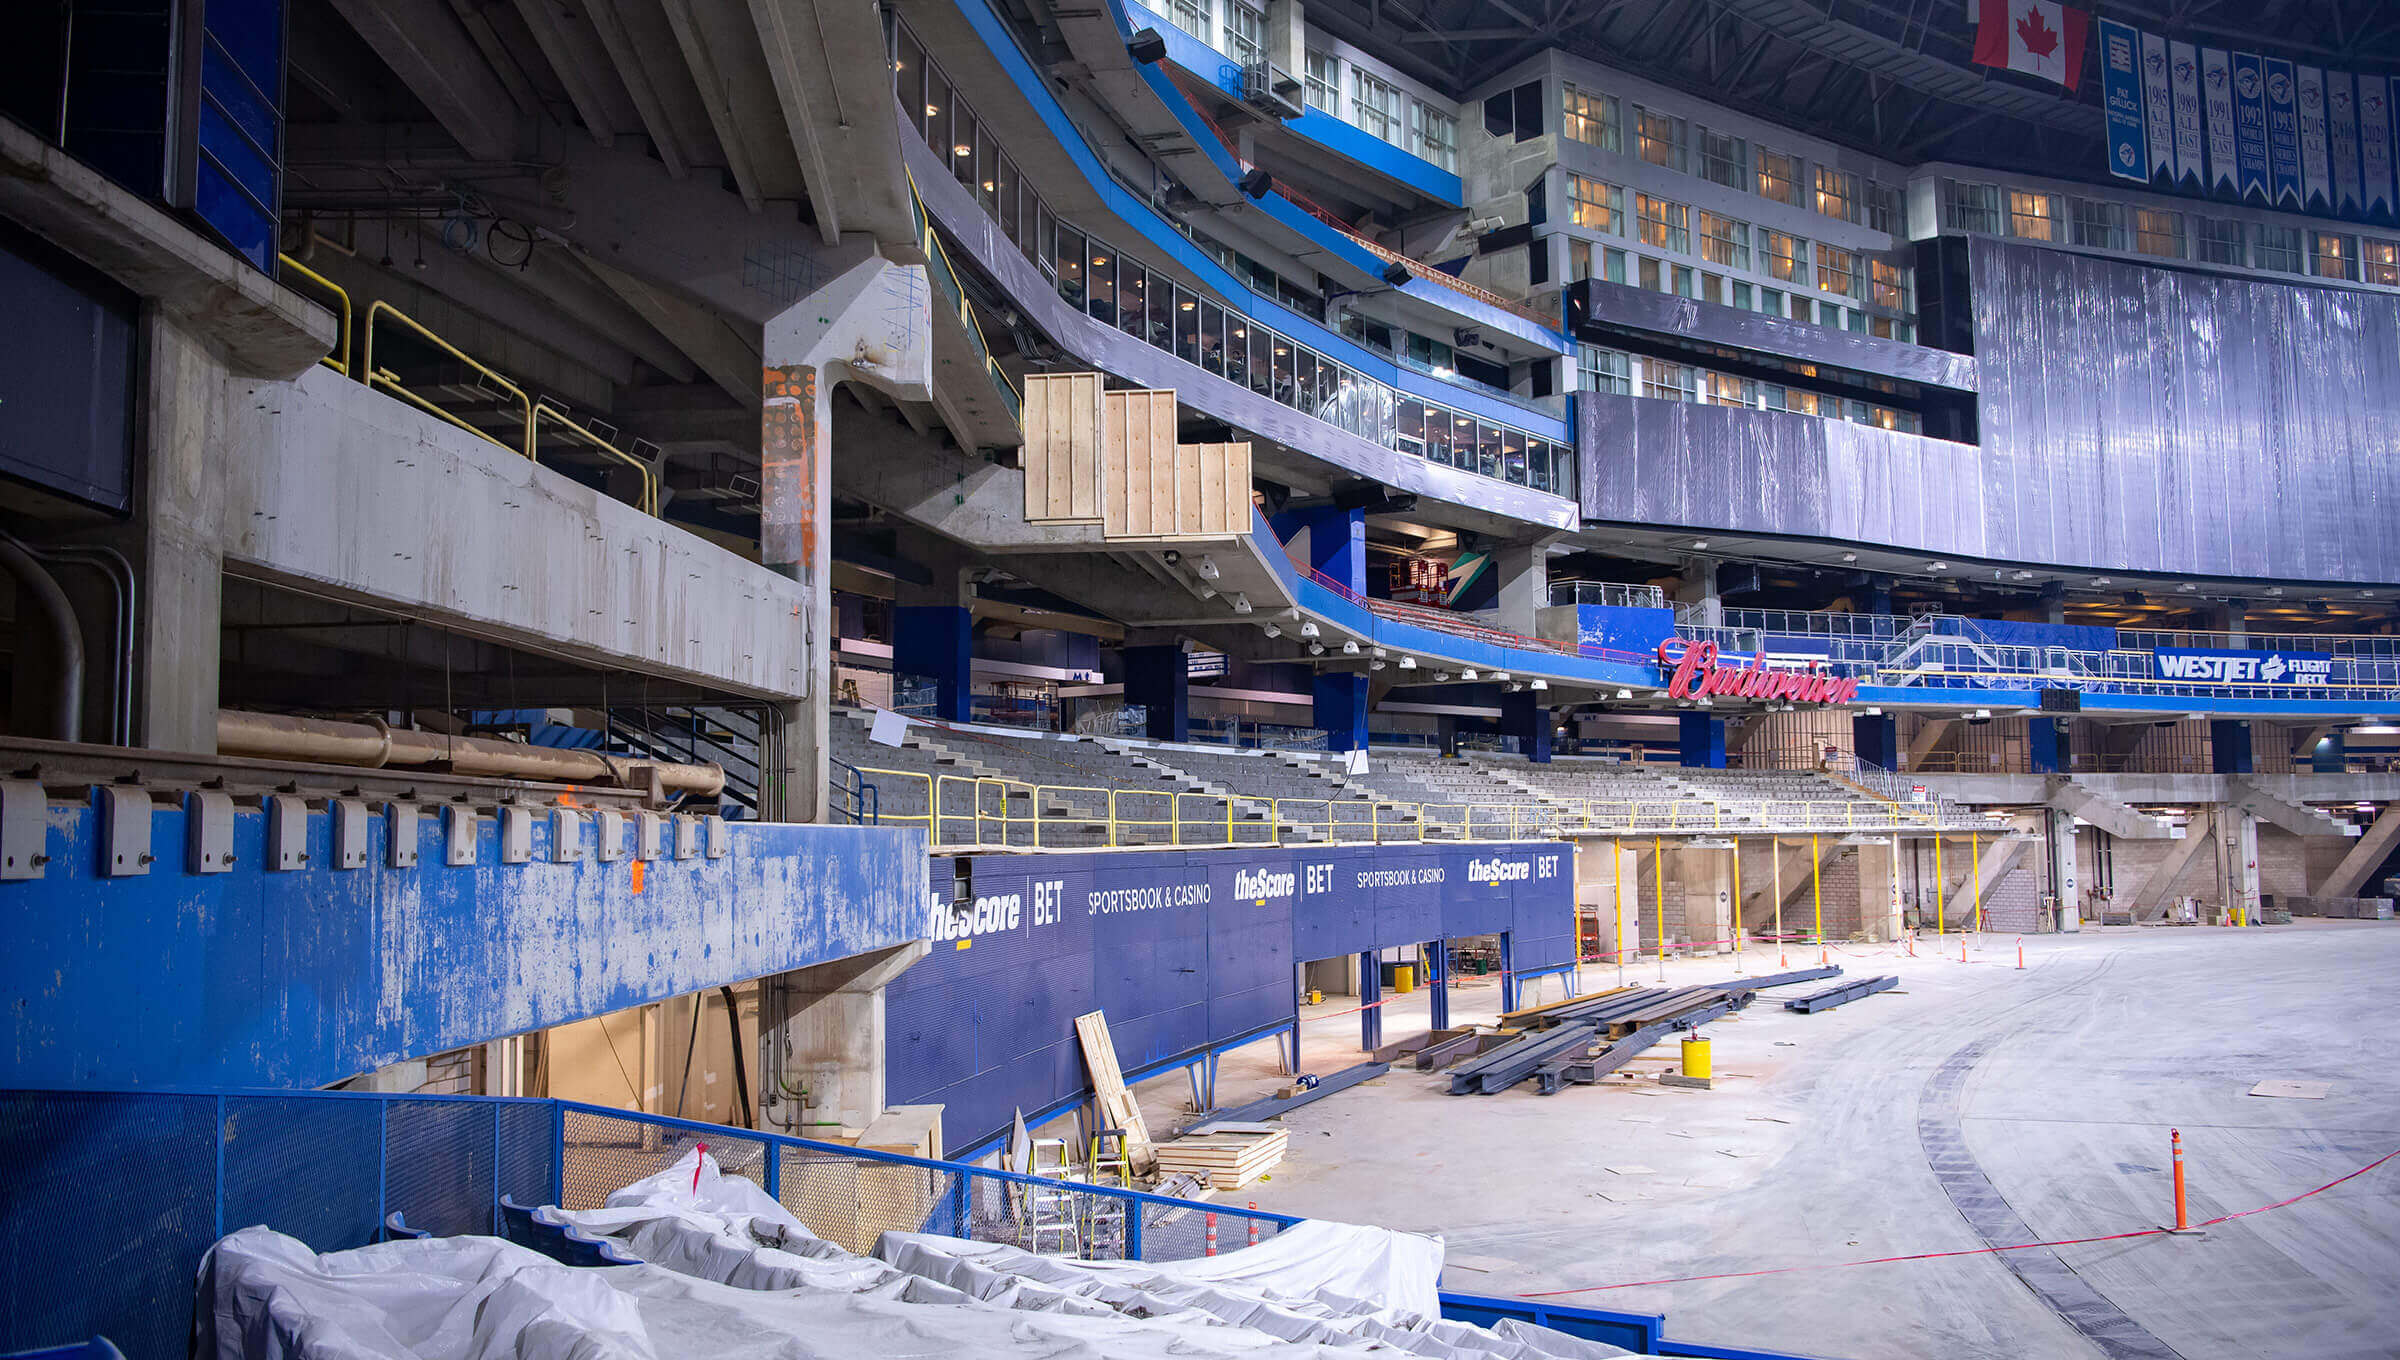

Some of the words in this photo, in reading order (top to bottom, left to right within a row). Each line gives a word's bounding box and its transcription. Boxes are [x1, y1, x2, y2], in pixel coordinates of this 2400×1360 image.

[2176, 92, 2197, 114] 1989
[2209, 98, 2231, 121] 1991
[2240, 104, 2263, 127] 1992
[2272, 111, 2296, 132] 1993
[1658, 637, 1859, 704] Budweiser
[2158, 655, 2261, 685] WESTJET
[2288, 659, 2332, 673] FLIGHT
[2295, 674, 2328, 685] DECK
[1357, 870, 1410, 889] SPORTSBOOK
[1411, 871, 1417, 883] &
[1418, 867, 1445, 883] CASINO
[1468, 858, 1529, 882] theScore
[1538, 855, 1559, 879] BET
[1234, 868, 1295, 900] theScore
[1306, 864, 1334, 894] BET
[1034, 880, 1064, 926] BET
[1088, 886, 1163, 915] SPORTSBOOK
[1165, 890, 1173, 907] &
[1174, 884, 1211, 905] CASINO
